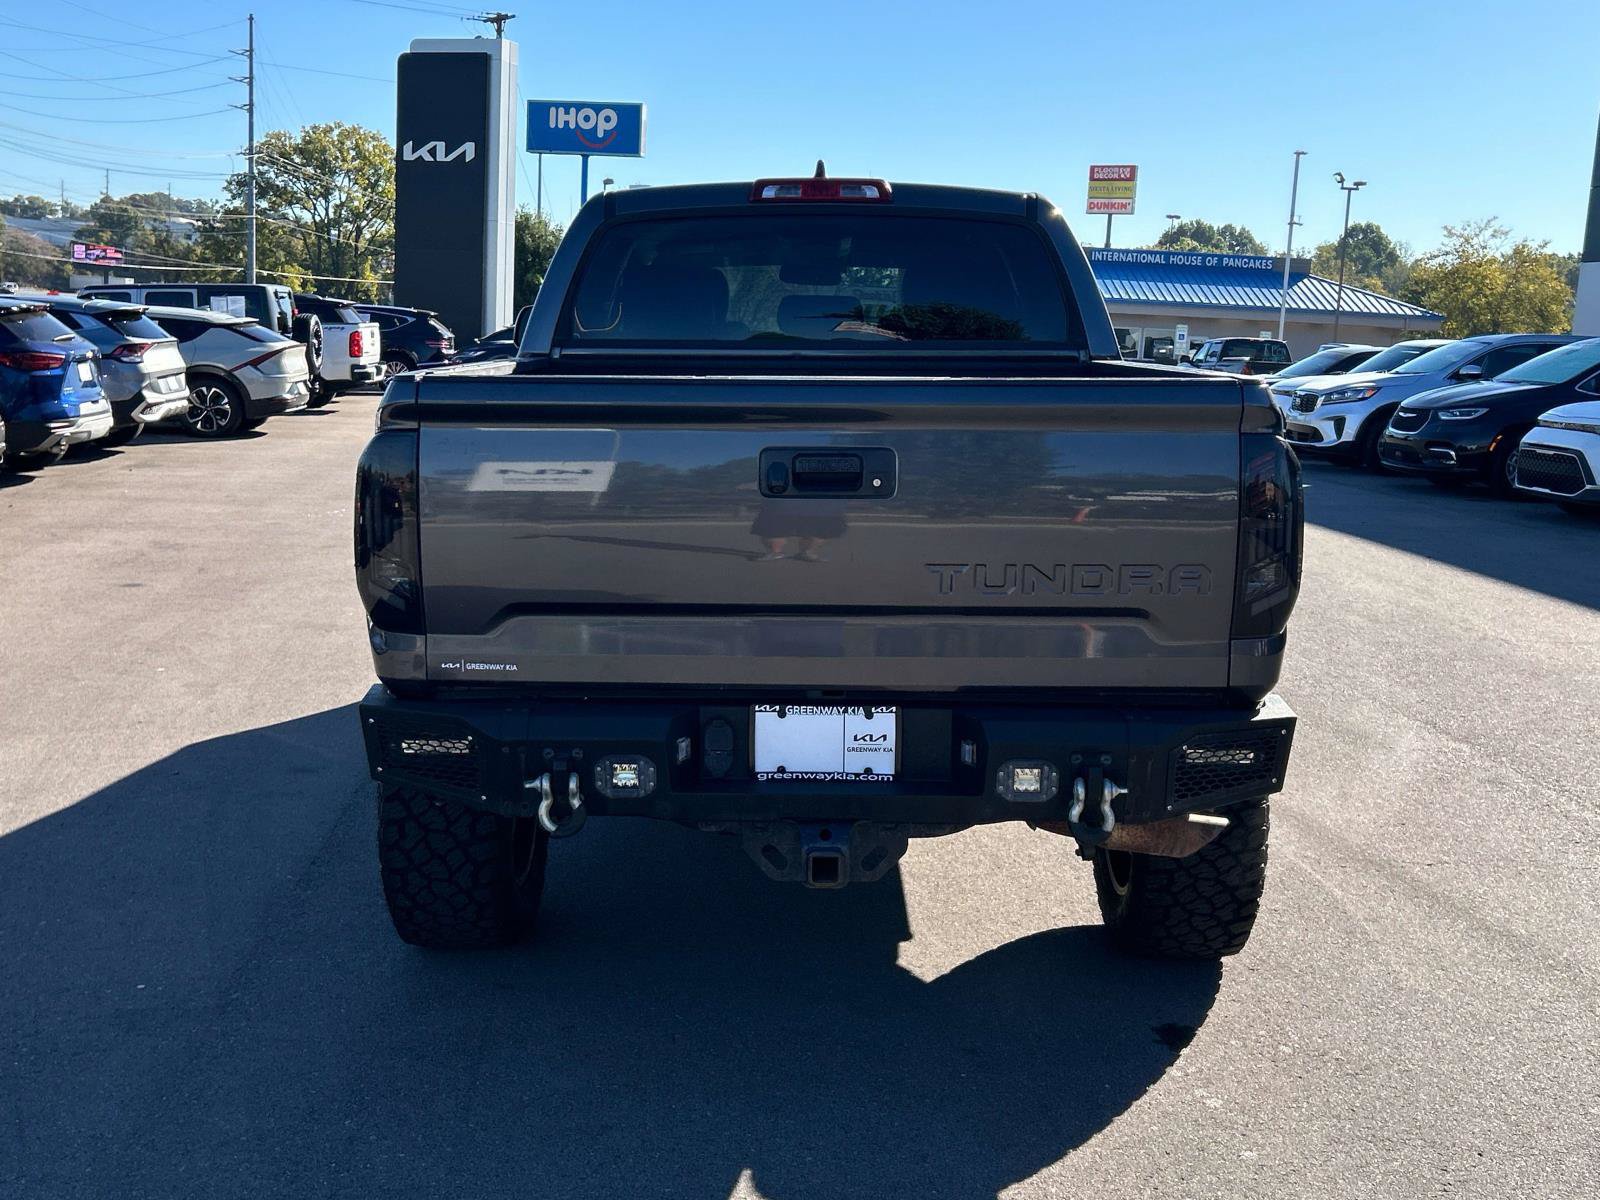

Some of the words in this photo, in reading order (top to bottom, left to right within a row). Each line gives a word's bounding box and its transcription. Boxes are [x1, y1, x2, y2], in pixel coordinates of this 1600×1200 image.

[403, 140, 475, 162] KIA
[1088, 201, 1131, 210] DUNKIN'
[1091, 251, 1166, 264] INTERNATIONAL
[1169, 255, 1202, 266] HOUSE
[1205, 256, 1218, 267] OF
[1223, 257, 1273, 270] PANCAKES
[924, 563, 1213, 596] TUNDRA
[755, 704, 780, 712] KIA
[785, 705, 845, 716] GREENWAY
[848, 706, 865, 716] KIA
[853, 733, 887, 742] KIA
[757, 772, 893, 781] greenwaykia.com
